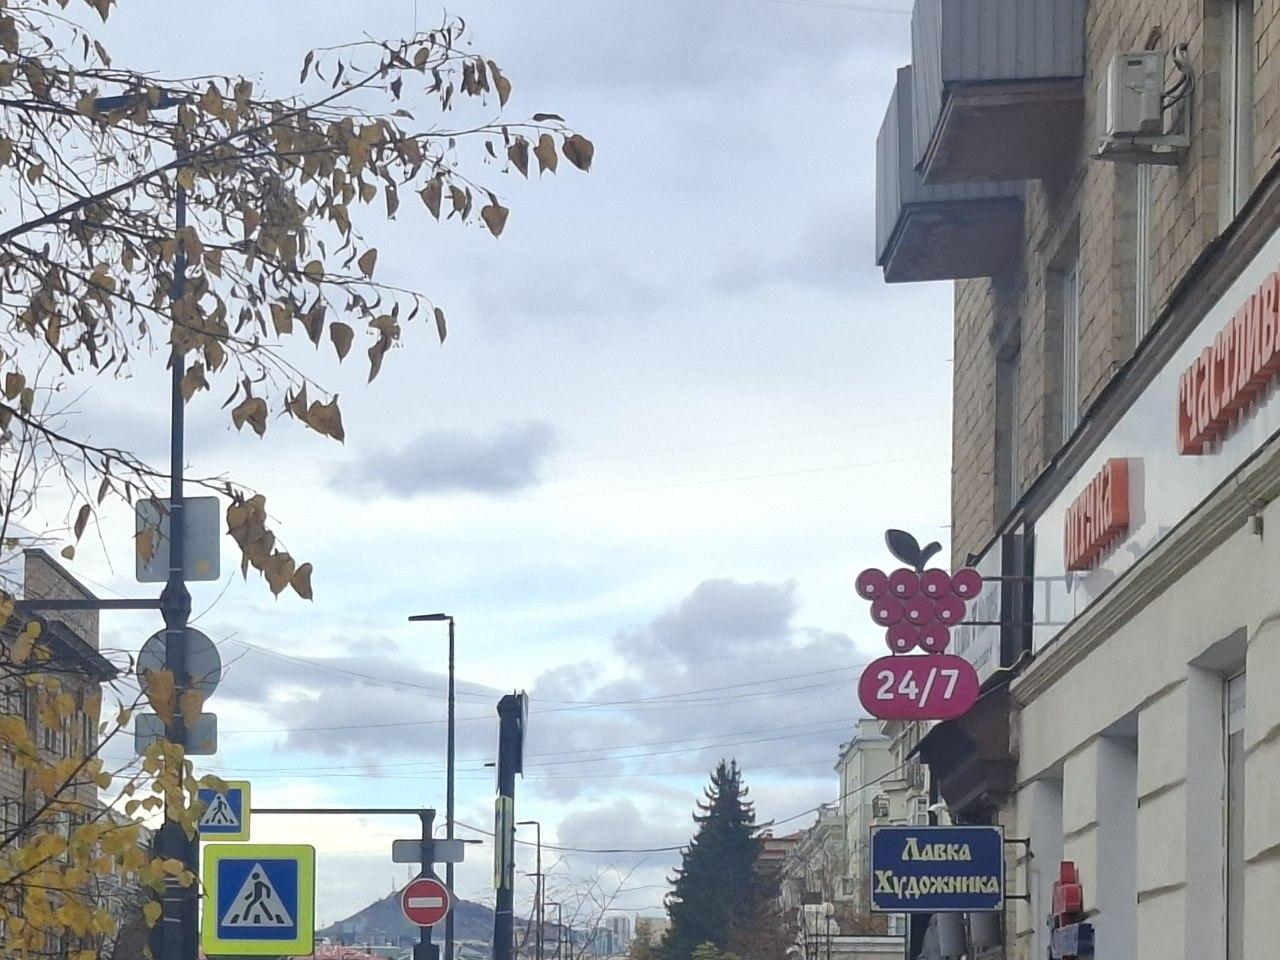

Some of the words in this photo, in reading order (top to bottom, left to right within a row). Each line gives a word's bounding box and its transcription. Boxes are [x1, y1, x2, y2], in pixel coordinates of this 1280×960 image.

[877, 667, 959, 708] 24/7
[901, 837, 972, 861] Лавка
[874, 870, 1000, 899] Художника
